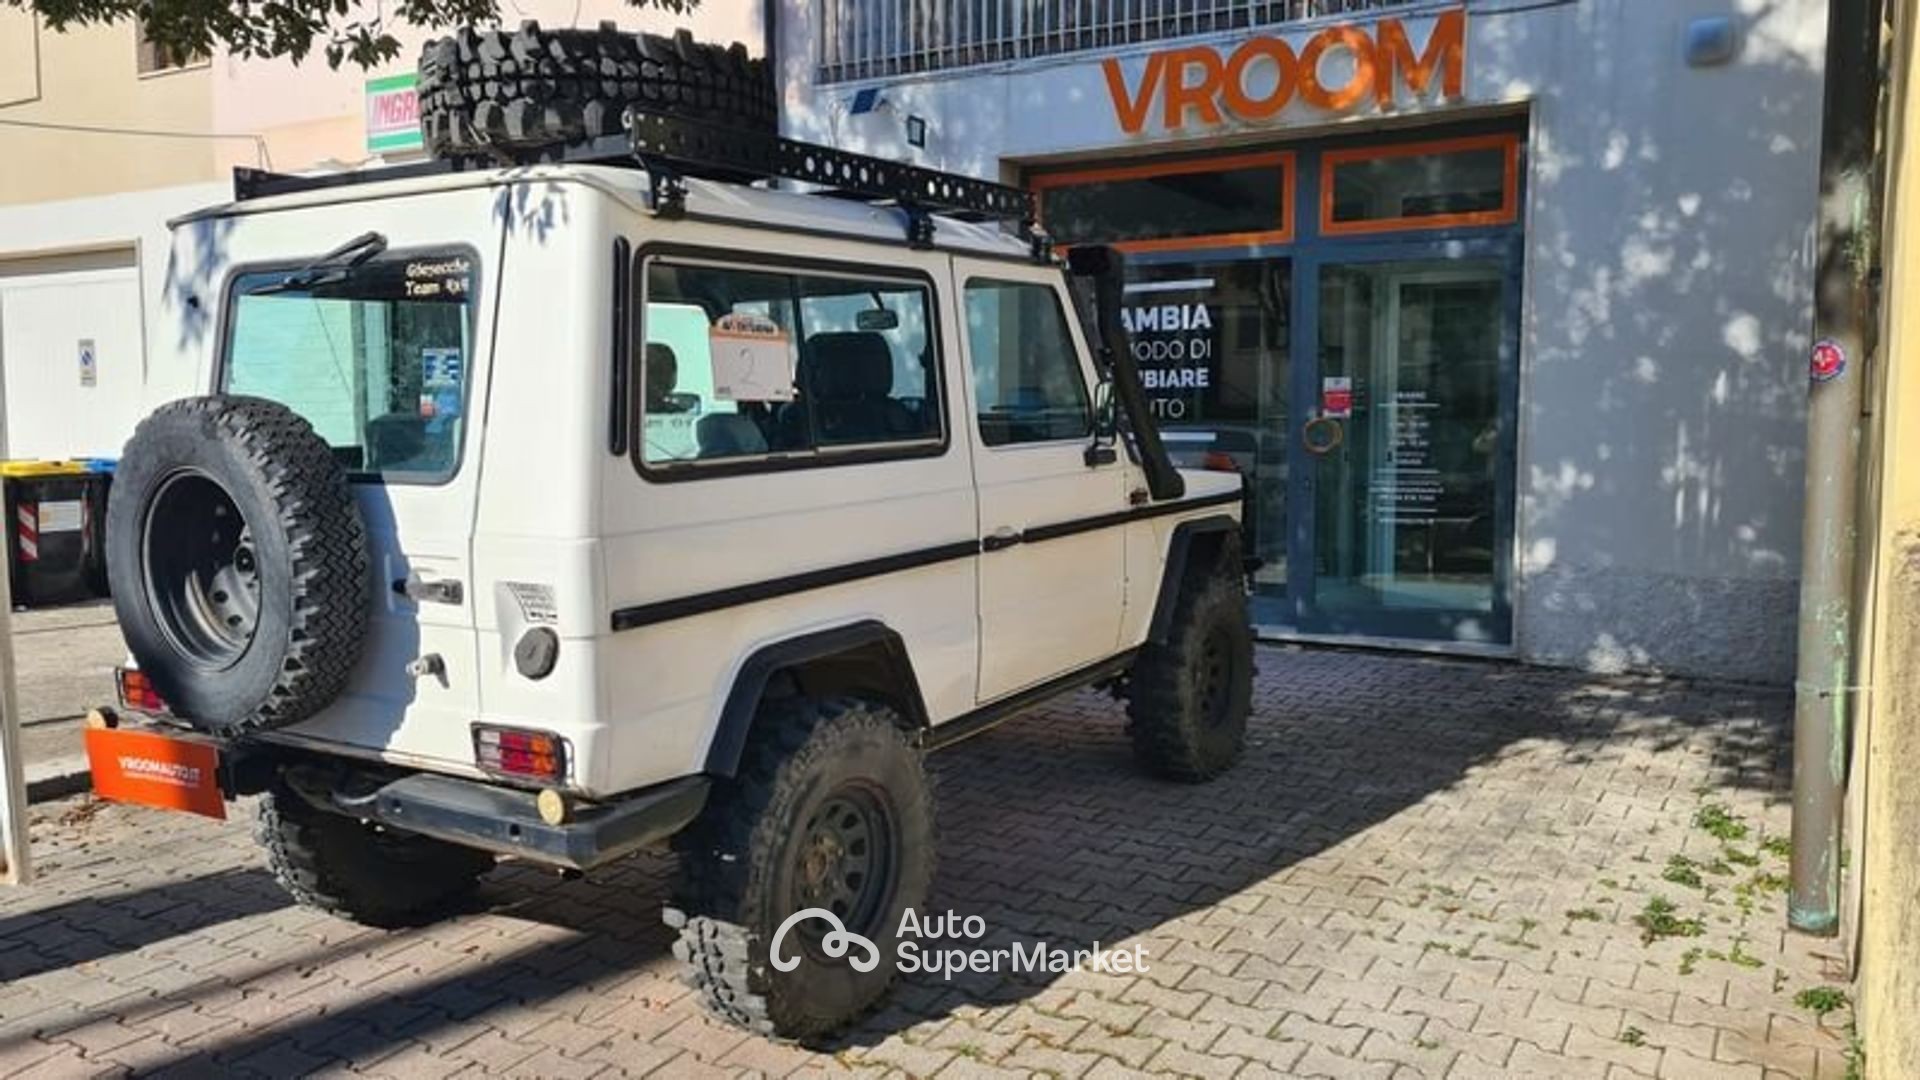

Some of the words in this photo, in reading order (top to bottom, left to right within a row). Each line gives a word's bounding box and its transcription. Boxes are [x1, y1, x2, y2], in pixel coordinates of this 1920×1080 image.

[1102, 8, 1465, 134] VROOM
[405, 281, 440, 296] Team
[1130, 340, 1184, 360] ODO
[1190, 338, 1211, 359] DI
[740, 347, 761, 386] 2
[1138, 368, 1209, 388] BIARE
[1151, 398, 1185, 417] TO
